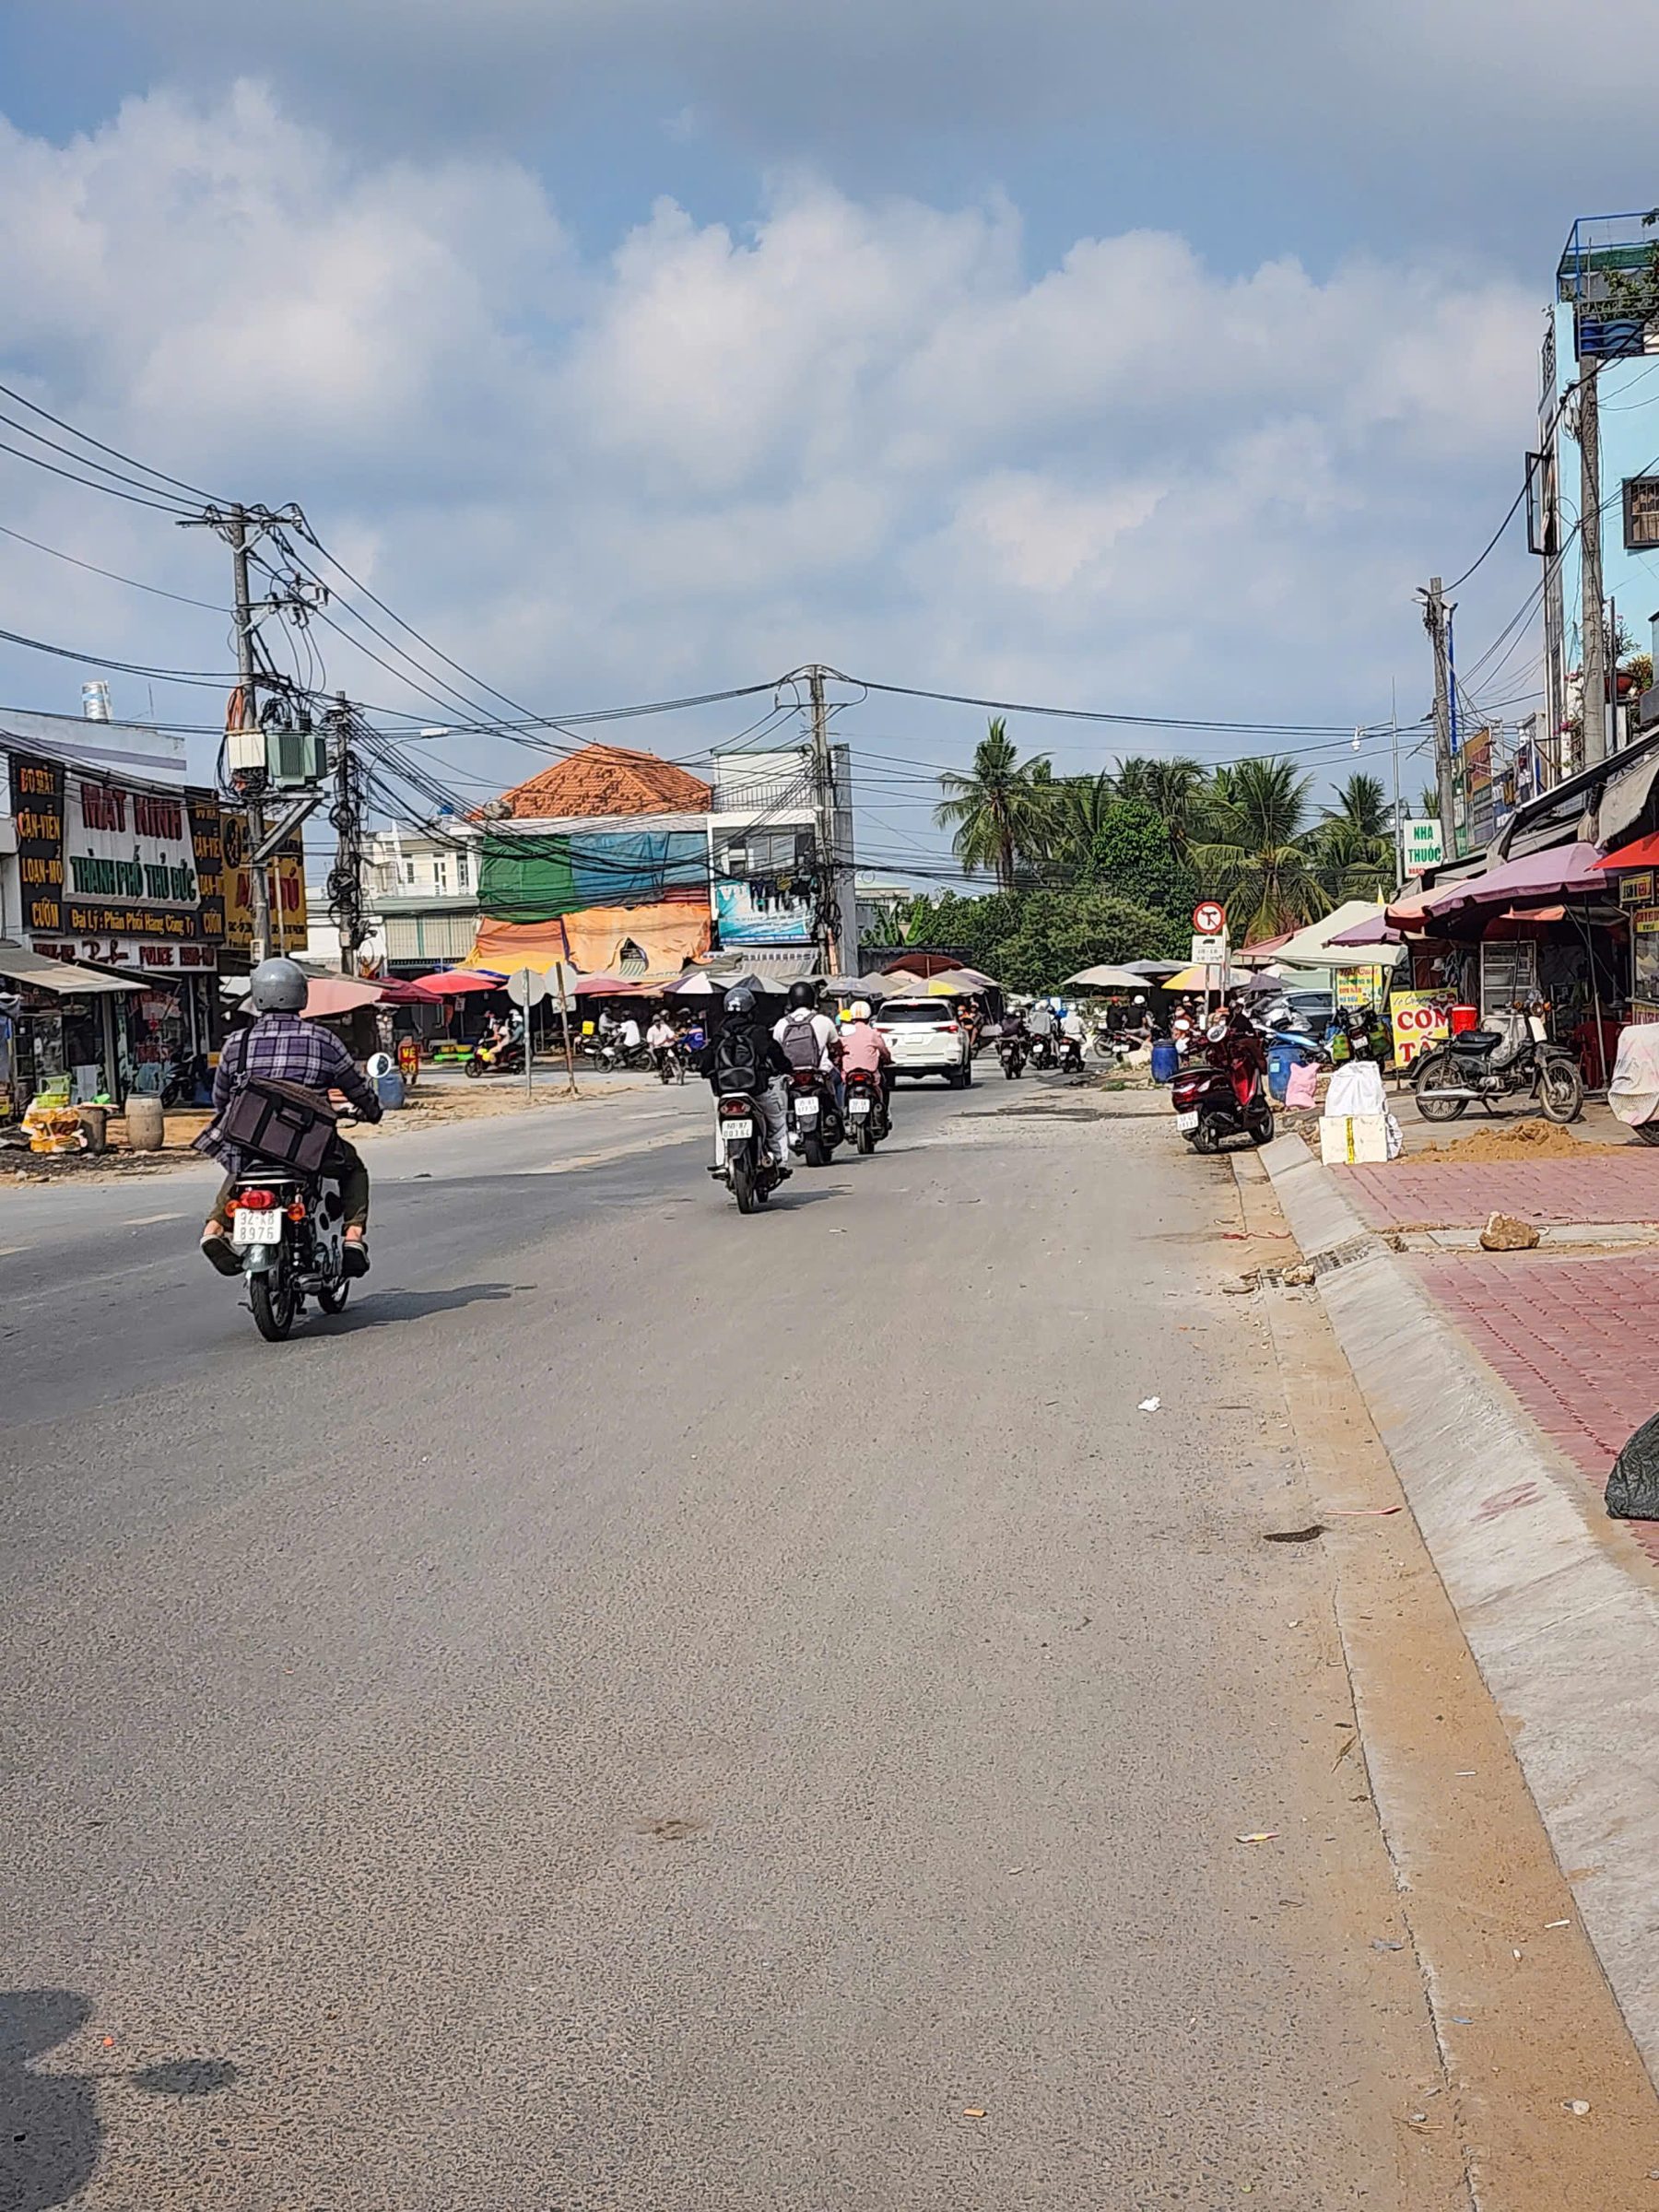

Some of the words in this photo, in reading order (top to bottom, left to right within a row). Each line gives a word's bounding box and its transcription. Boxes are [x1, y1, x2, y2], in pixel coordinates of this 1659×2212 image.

[69, 848, 116, 894] THÀNH
[116, 844, 143, 898] PHỐ
[144, 853, 170, 900] THỦ
[170, 859, 197, 902] ĐỨC
[72, 909, 86, 933] Đại
[126, 909, 143, 931] Phối
[1398, 1031, 1433, 1062] TẤ
[240, 1227, 275, 1241] 8976
